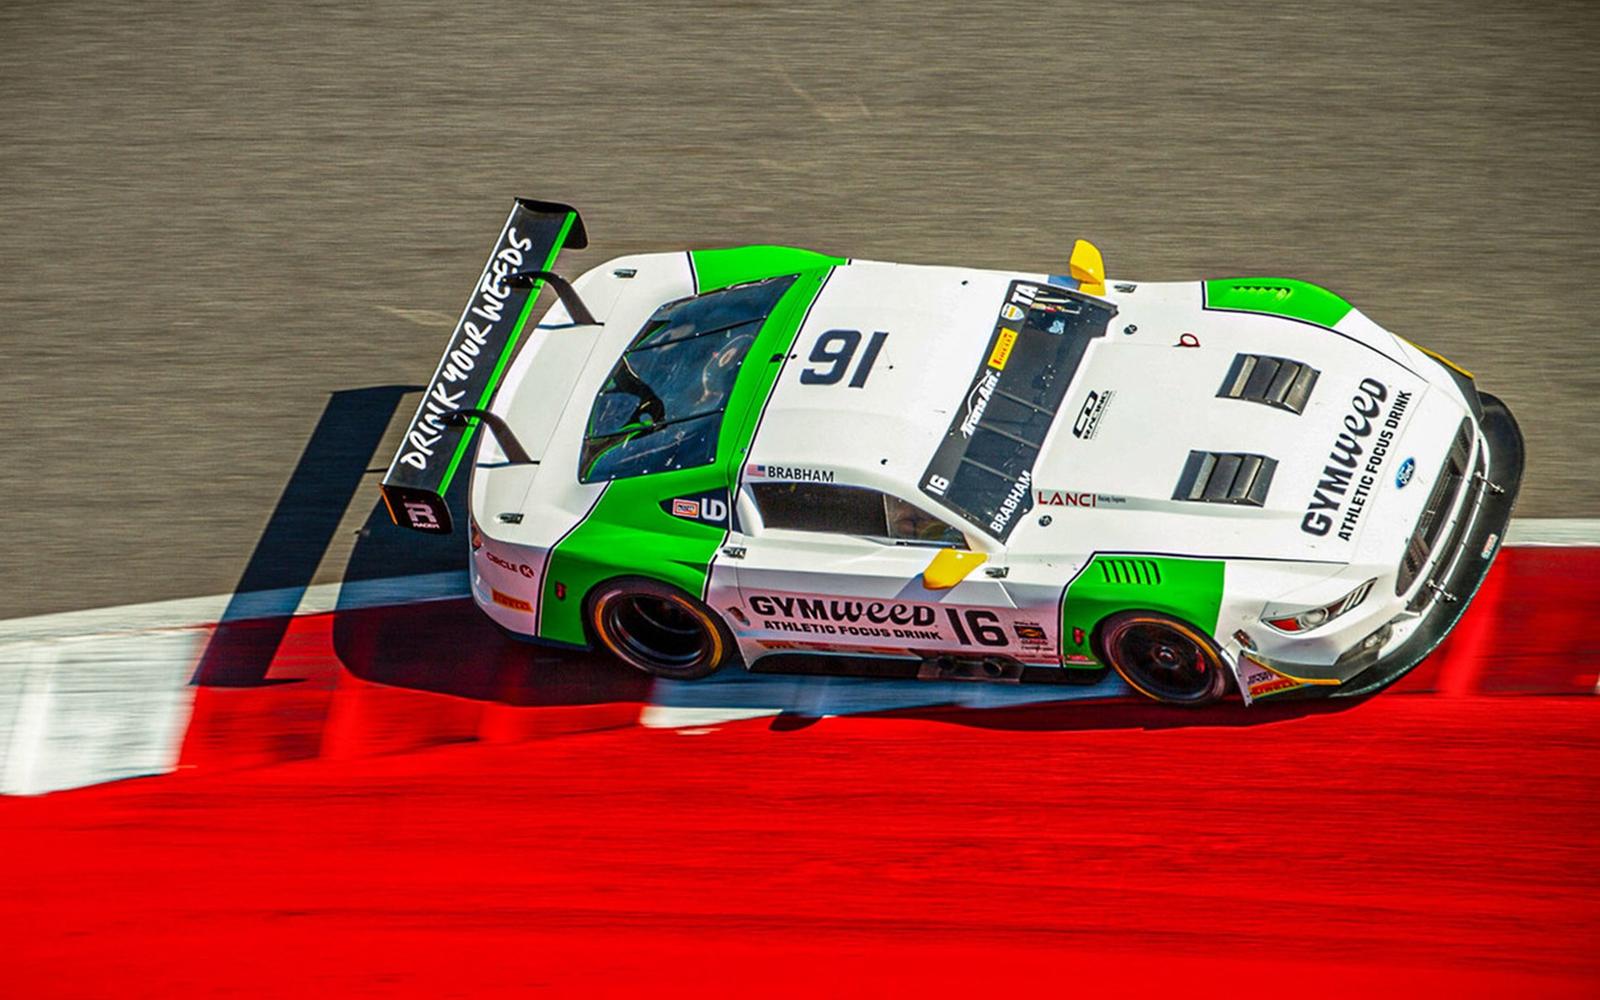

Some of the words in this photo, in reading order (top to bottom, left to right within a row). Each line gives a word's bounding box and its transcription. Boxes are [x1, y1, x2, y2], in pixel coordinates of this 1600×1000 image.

[1011, 284, 1039, 306] TA
[400, 382, 466, 470] DRINK
[443, 322, 494, 385] YOUR
[472, 227, 533, 322] WEEDS
[960, 396, 985, 439] Trans
[977, 375, 1001, 402] Am
[768, 465, 835, 483] BRABHAM
[1338, 467, 1374, 541] ATHLETIC
[1367, 430, 1394, 475] FOCUS
[1386, 390, 1412, 432] DRINK
[1398, 459, 1415, 487] Ford
[926, 474, 949, 495] 16
[990, 470, 1033, 533] BRABHAM
[1038, 491, 1097, 508] LANCI
[764, 620, 837, 635] ATHLETIC
[839, 625, 891, 638] FOCUS
[894, 628, 944, 642] DRINK
[946, 608, 1010, 647] 16
